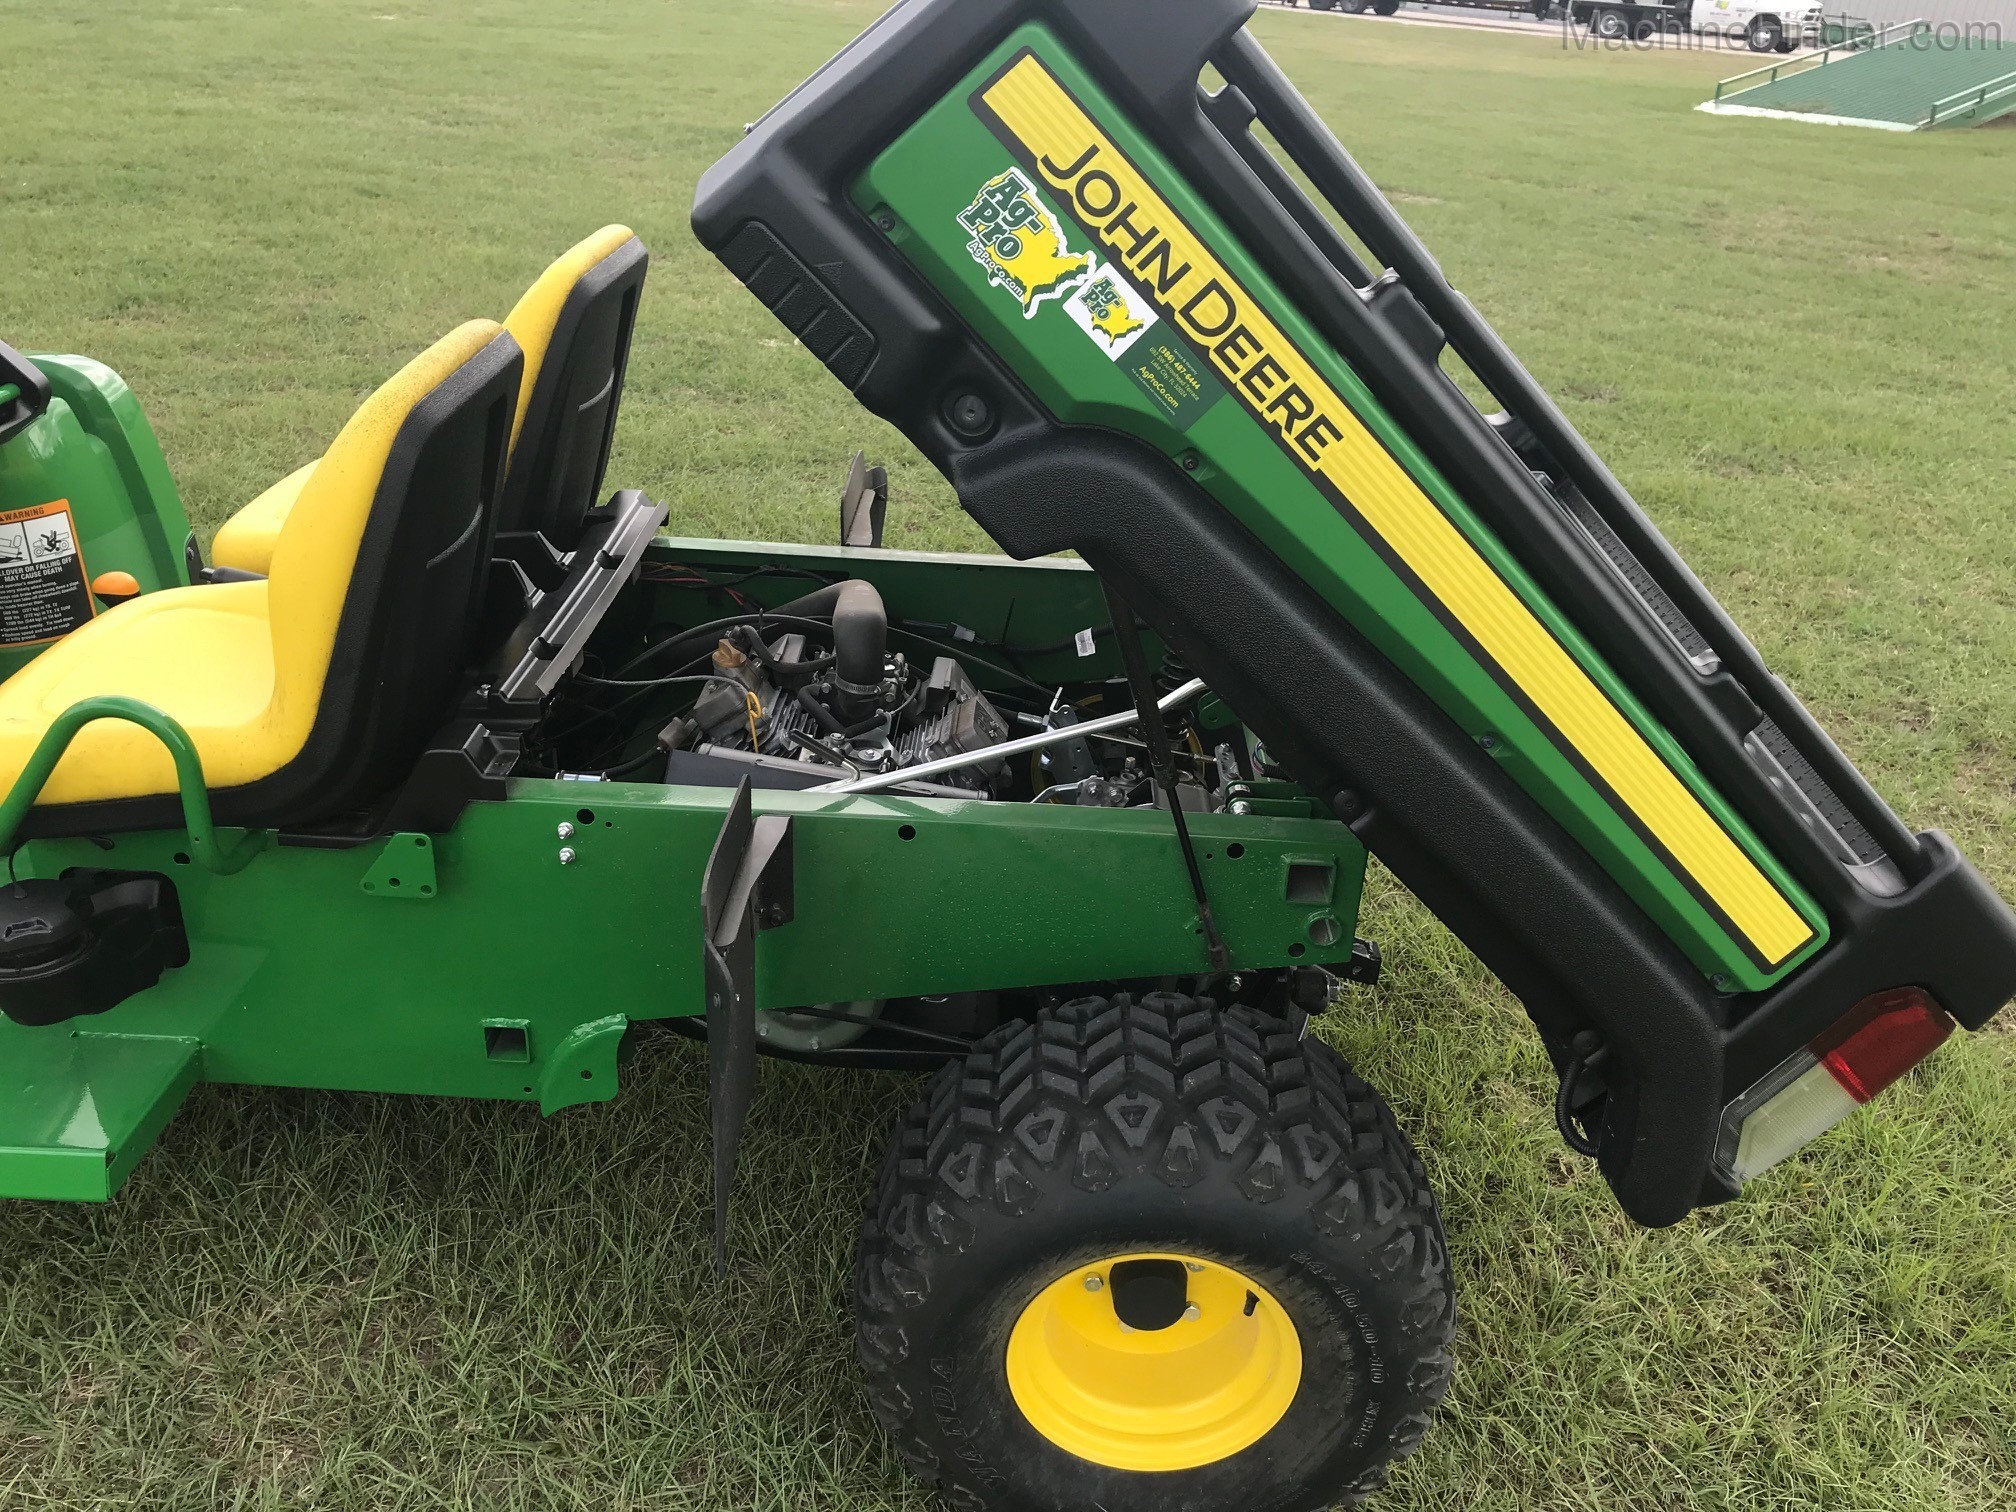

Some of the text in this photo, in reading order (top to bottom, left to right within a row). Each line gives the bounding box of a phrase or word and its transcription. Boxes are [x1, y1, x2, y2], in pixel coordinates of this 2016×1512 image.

[958, 195, 1022, 260] Pro
[969, 240, 1024, 297] AgProCo.com
[1040, 143, 1344, 463] JOHN DEERE
[1078, 289, 1110, 321] Pro
[1139, 366, 1178, 408] AgProCo.com
[1151, 359, 1162, 370] Lake
[1174, 384, 1188, 398] 32024
[1157, 355, 1166, 364] SW
[1164, 363, 1186, 386] Arrowhead
[1185, 384, 1200, 401] Terrace
[1158, 346, 1201, 390] (386) 487-6444
[4, 507, 45, 520] WARNING
[21, 571, 42, 580] CAUSE
[42, 566, 63, 576] DEATH
[36, 559, 62, 570] FALLING
[62, 556, 72, 565] OFF
